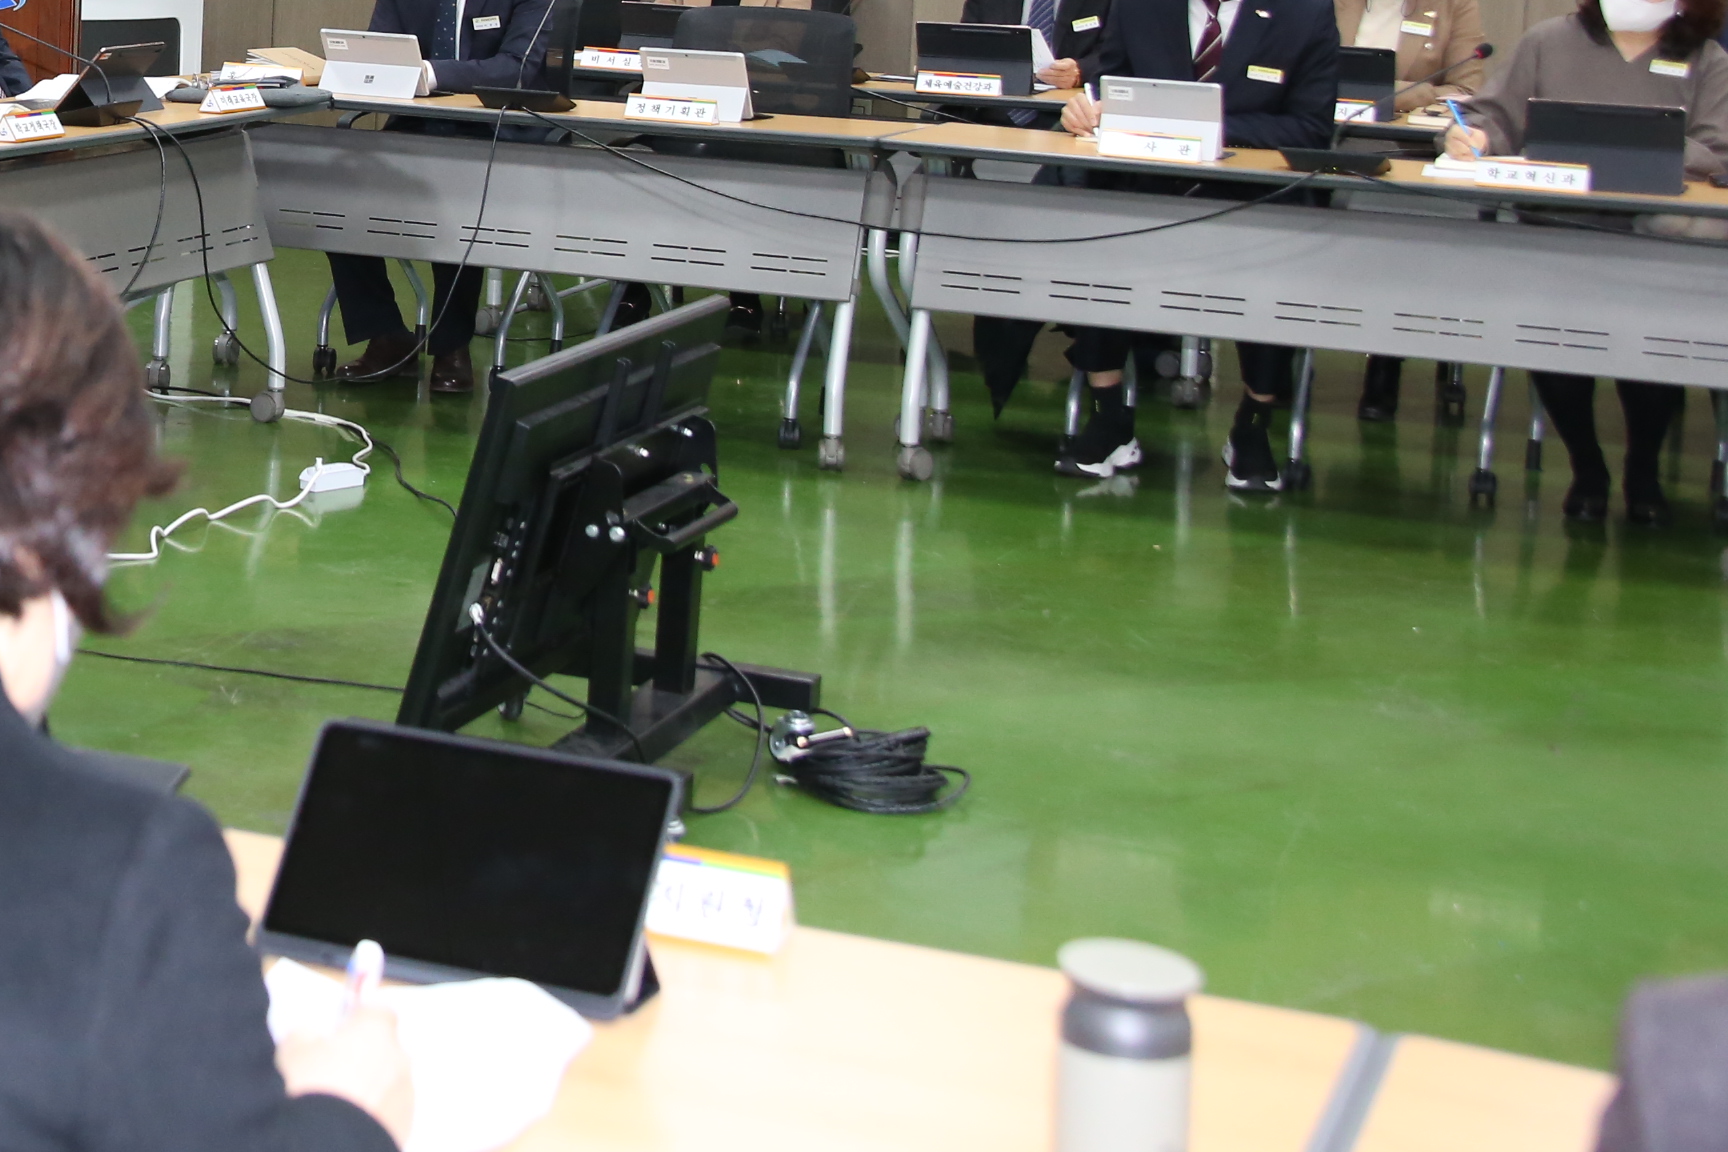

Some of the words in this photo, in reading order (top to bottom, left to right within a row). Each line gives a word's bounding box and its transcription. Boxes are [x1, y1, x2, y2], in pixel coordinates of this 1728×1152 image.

[923, 79, 993, 92] 체육예술건강과
[220, 92, 259, 106] 미래교육국장
[634, 102, 707, 119] 정책기획관
[14, 118, 58, 135] 학교정책국장
[1486, 167, 1576, 187] 학교혁신과
